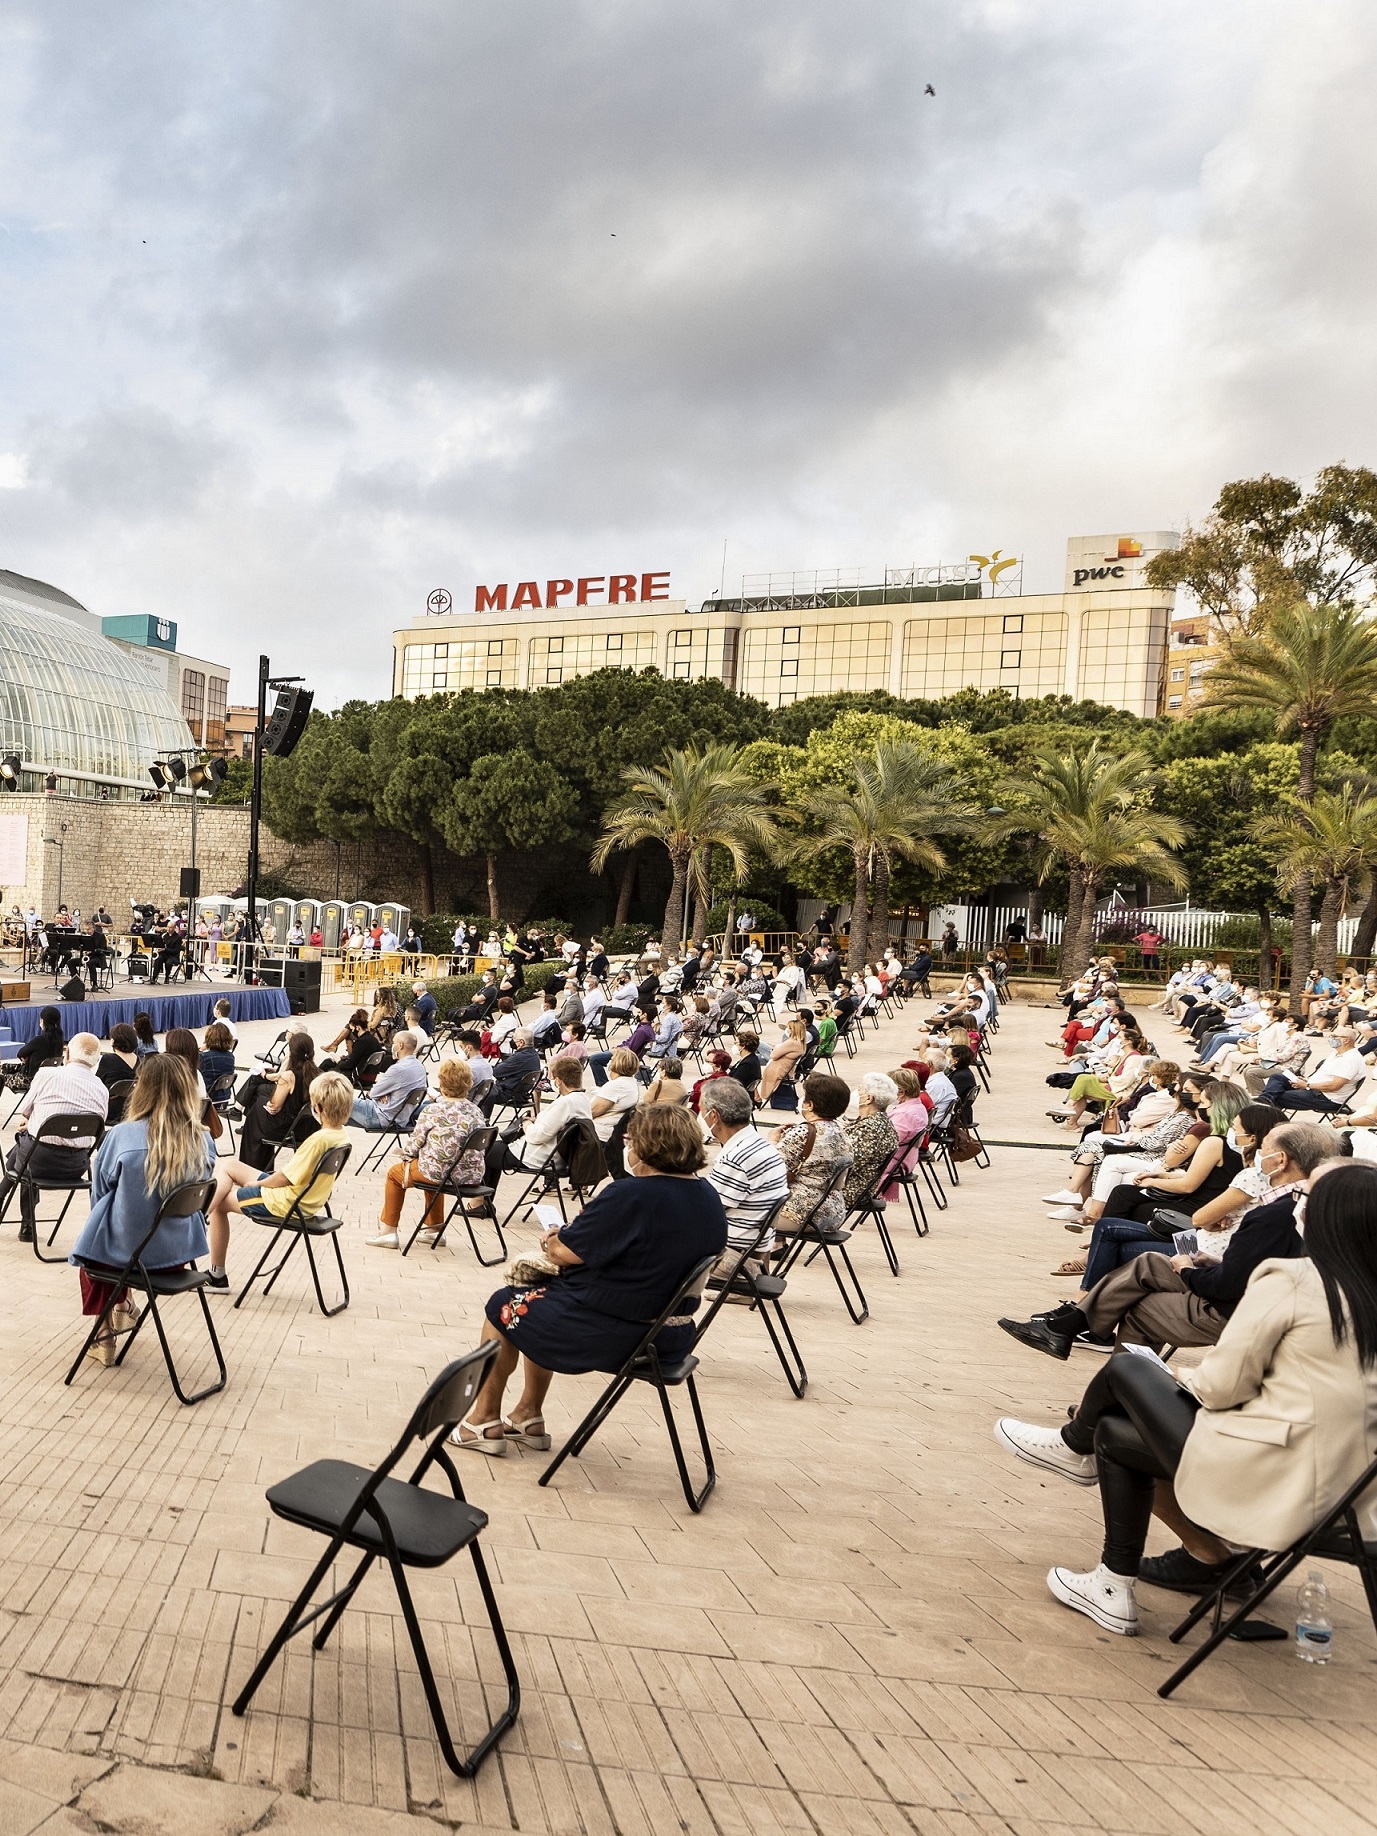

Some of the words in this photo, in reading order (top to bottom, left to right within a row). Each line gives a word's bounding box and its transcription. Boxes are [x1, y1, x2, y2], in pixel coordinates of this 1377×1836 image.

[890, 564, 971, 589] MGS
[1073, 564, 1125, 586] pwc
[475, 571, 671, 612] MAPFRE
